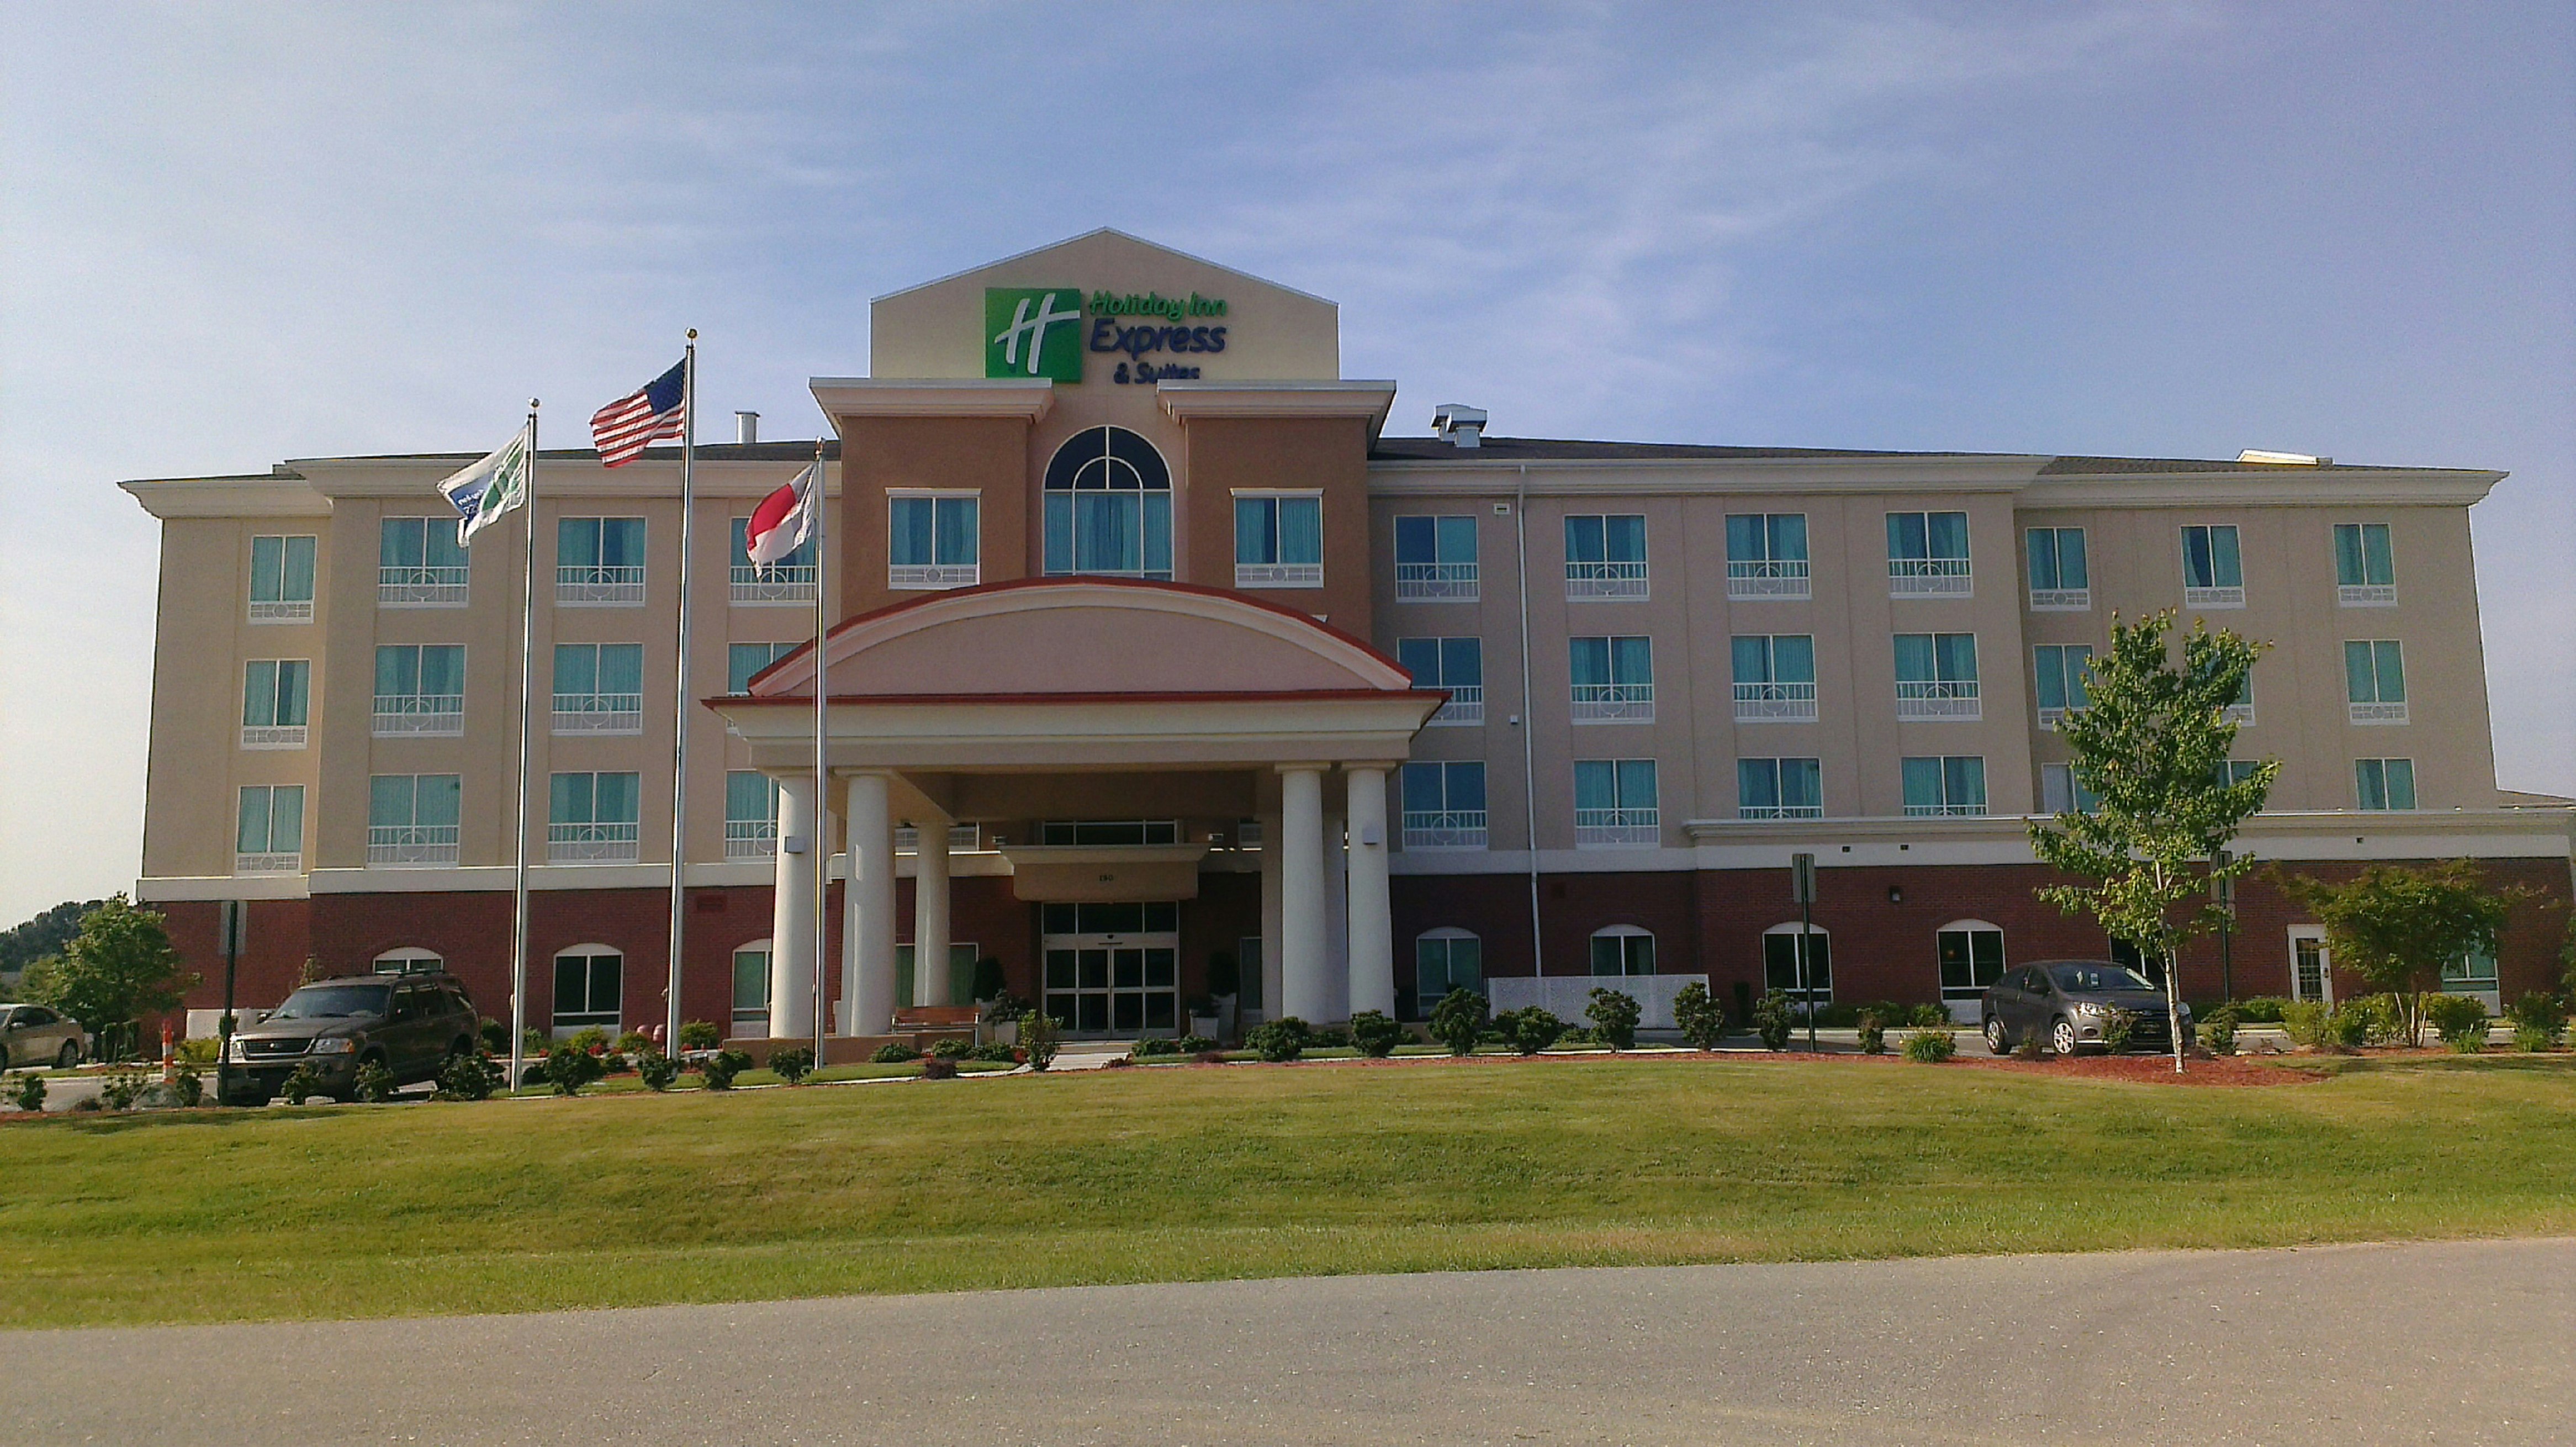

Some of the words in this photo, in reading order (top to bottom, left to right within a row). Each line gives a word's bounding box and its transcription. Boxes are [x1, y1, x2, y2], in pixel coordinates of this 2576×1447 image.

[1089, 291, 1186, 323] Holiday
[1189, 291, 1227, 316] Inn
[995, 293, 1081, 374] H
[1090, 318, 1226, 361] Express
[1114, 362, 1129, 384] &
[1134, 362, 1200, 384] Suites
